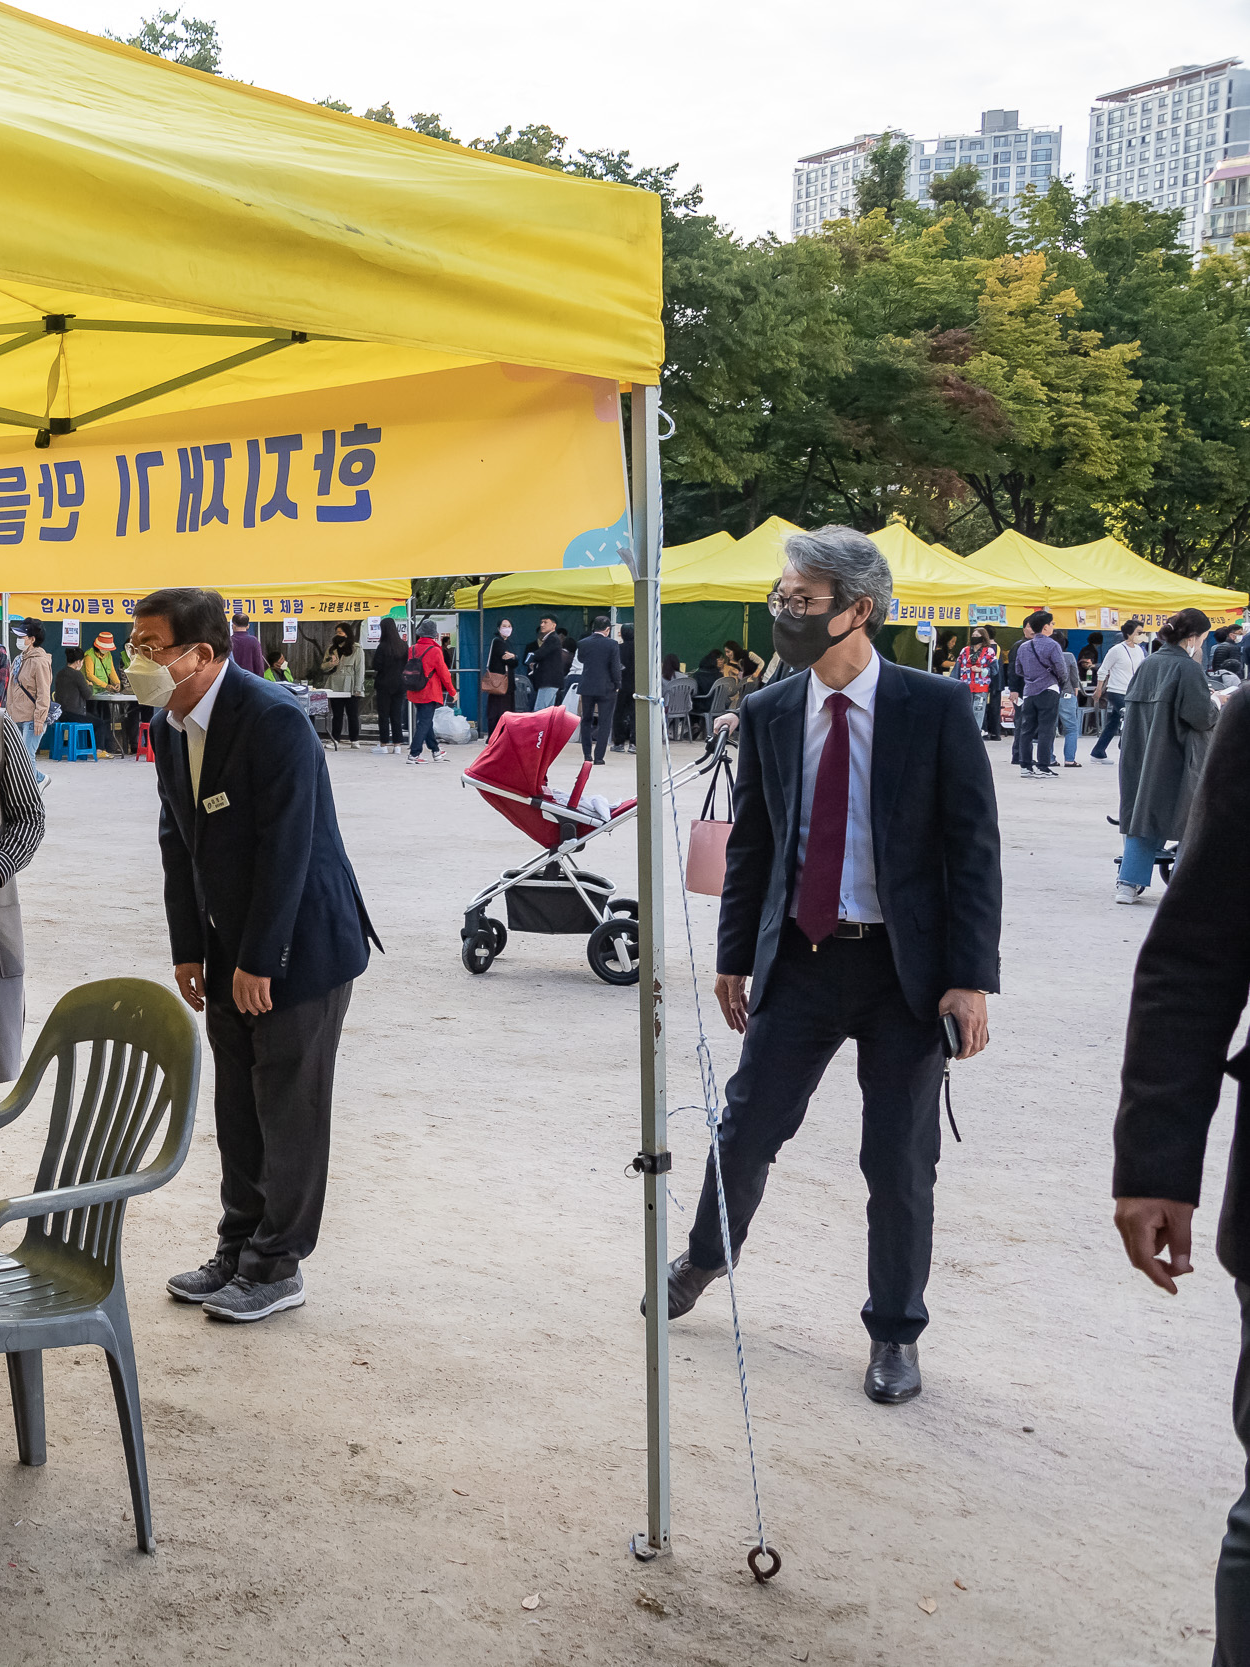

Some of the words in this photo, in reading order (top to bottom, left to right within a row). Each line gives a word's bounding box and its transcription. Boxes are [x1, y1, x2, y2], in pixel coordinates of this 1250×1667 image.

[40, 598, 114, 615] 업사이클링
[262, 599, 274, 614] 및
[280, 599, 304, 614] 체험
[900, 606, 935, 620] 보리내음
[939, 606, 961, 620] 밀내음
